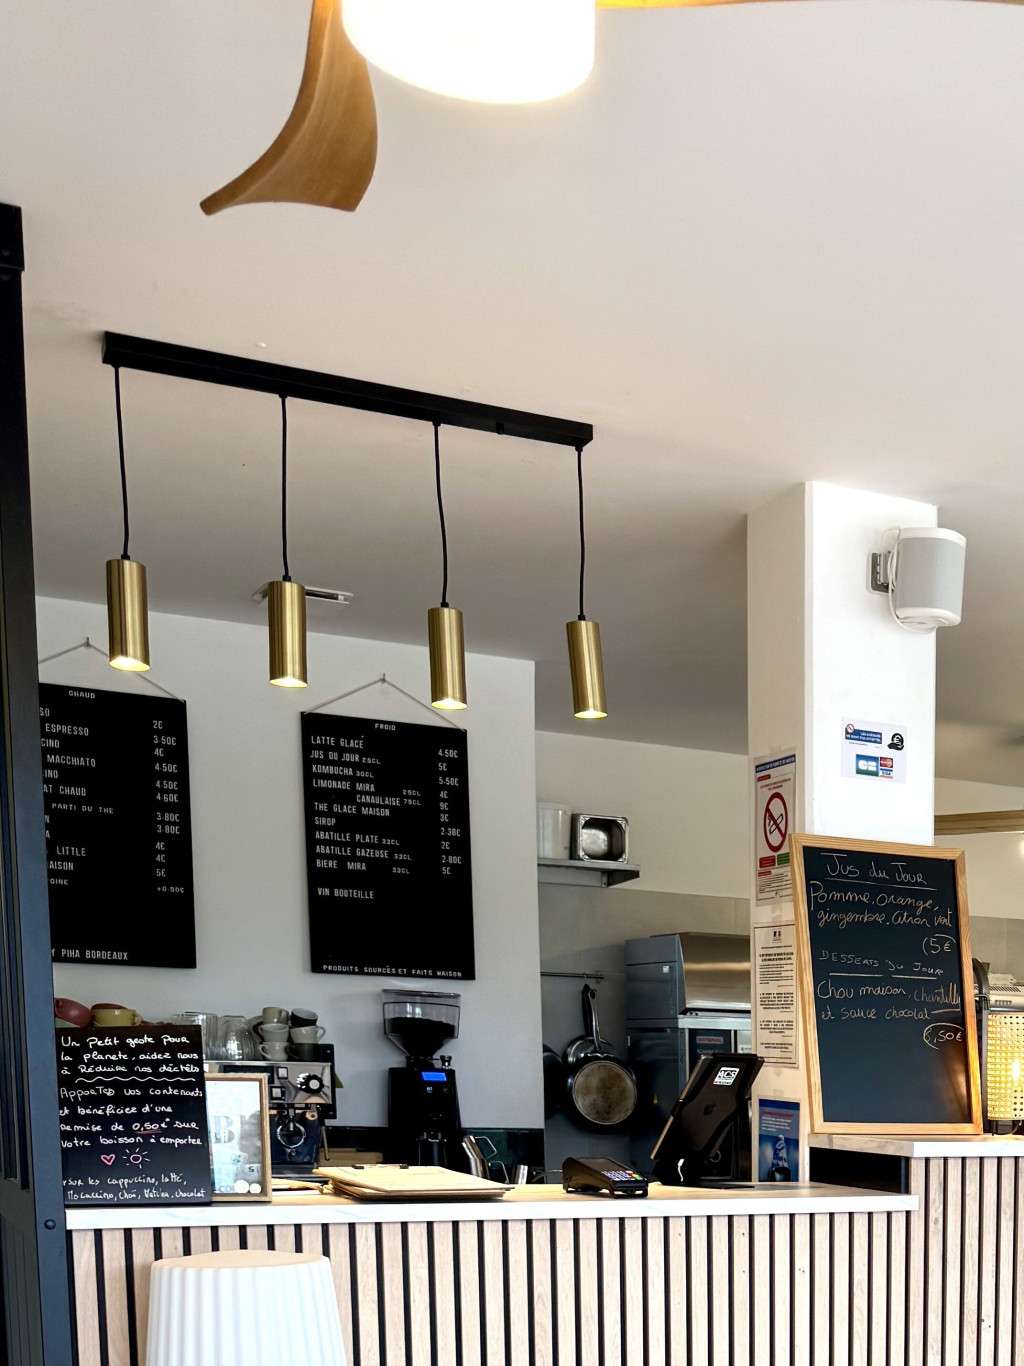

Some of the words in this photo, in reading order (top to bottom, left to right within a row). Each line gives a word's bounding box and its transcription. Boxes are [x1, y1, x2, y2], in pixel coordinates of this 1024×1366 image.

[45, 723, 89, 736] ESPRESSO
[311, 735, 336, 746] LATTE
[47, 754, 96, 768] MACCHIATO
[310, 750, 324, 759] JUS
[341, 753, 360, 762] JOUR
[312, 764, 354, 776] KOMBUCHA
[59, 785, 87, 796] CHAUD
[313, 778, 351, 790] LIMONADE
[356, 782, 376, 792] MIRA
[314, 802, 328, 812] THE
[333, 803, 357, 814] GLACE
[361, 806, 390, 817] MAISON
[314, 817, 336, 826] SIROP
[315, 830, 351, 842] ABATILLE
[356, 833, 379, 844] PLATE
[56, 846, 87, 857] LITTLE
[316, 844, 352, 856] ABATILLE
[356, 847, 389, 859] GAZEUSE
[316, 859, 339, 869] BIERE
[347, 861, 367, 871] MIRA
[820, 852, 860, 877] Jus
[869, 860, 889, 879] du
[317, 887, 330, 896] VIN
[334, 888, 375, 899] BOUTEILLE
[85, 949, 129, 961] BORDEAUX
[817, 978, 854, 999] Chou
[61, 1035, 81, 1047] Un
[61, 1051, 73, 1061] la
[139, 1052, 172, 1060] aidez
[134, 1065, 153, 1073] nos
[123, 1088, 142, 1096] vos
[59, 1106, 70, 1116] et
[110, 1122, 125, 1131] de
[99, 1135, 143, 1145] boisson
